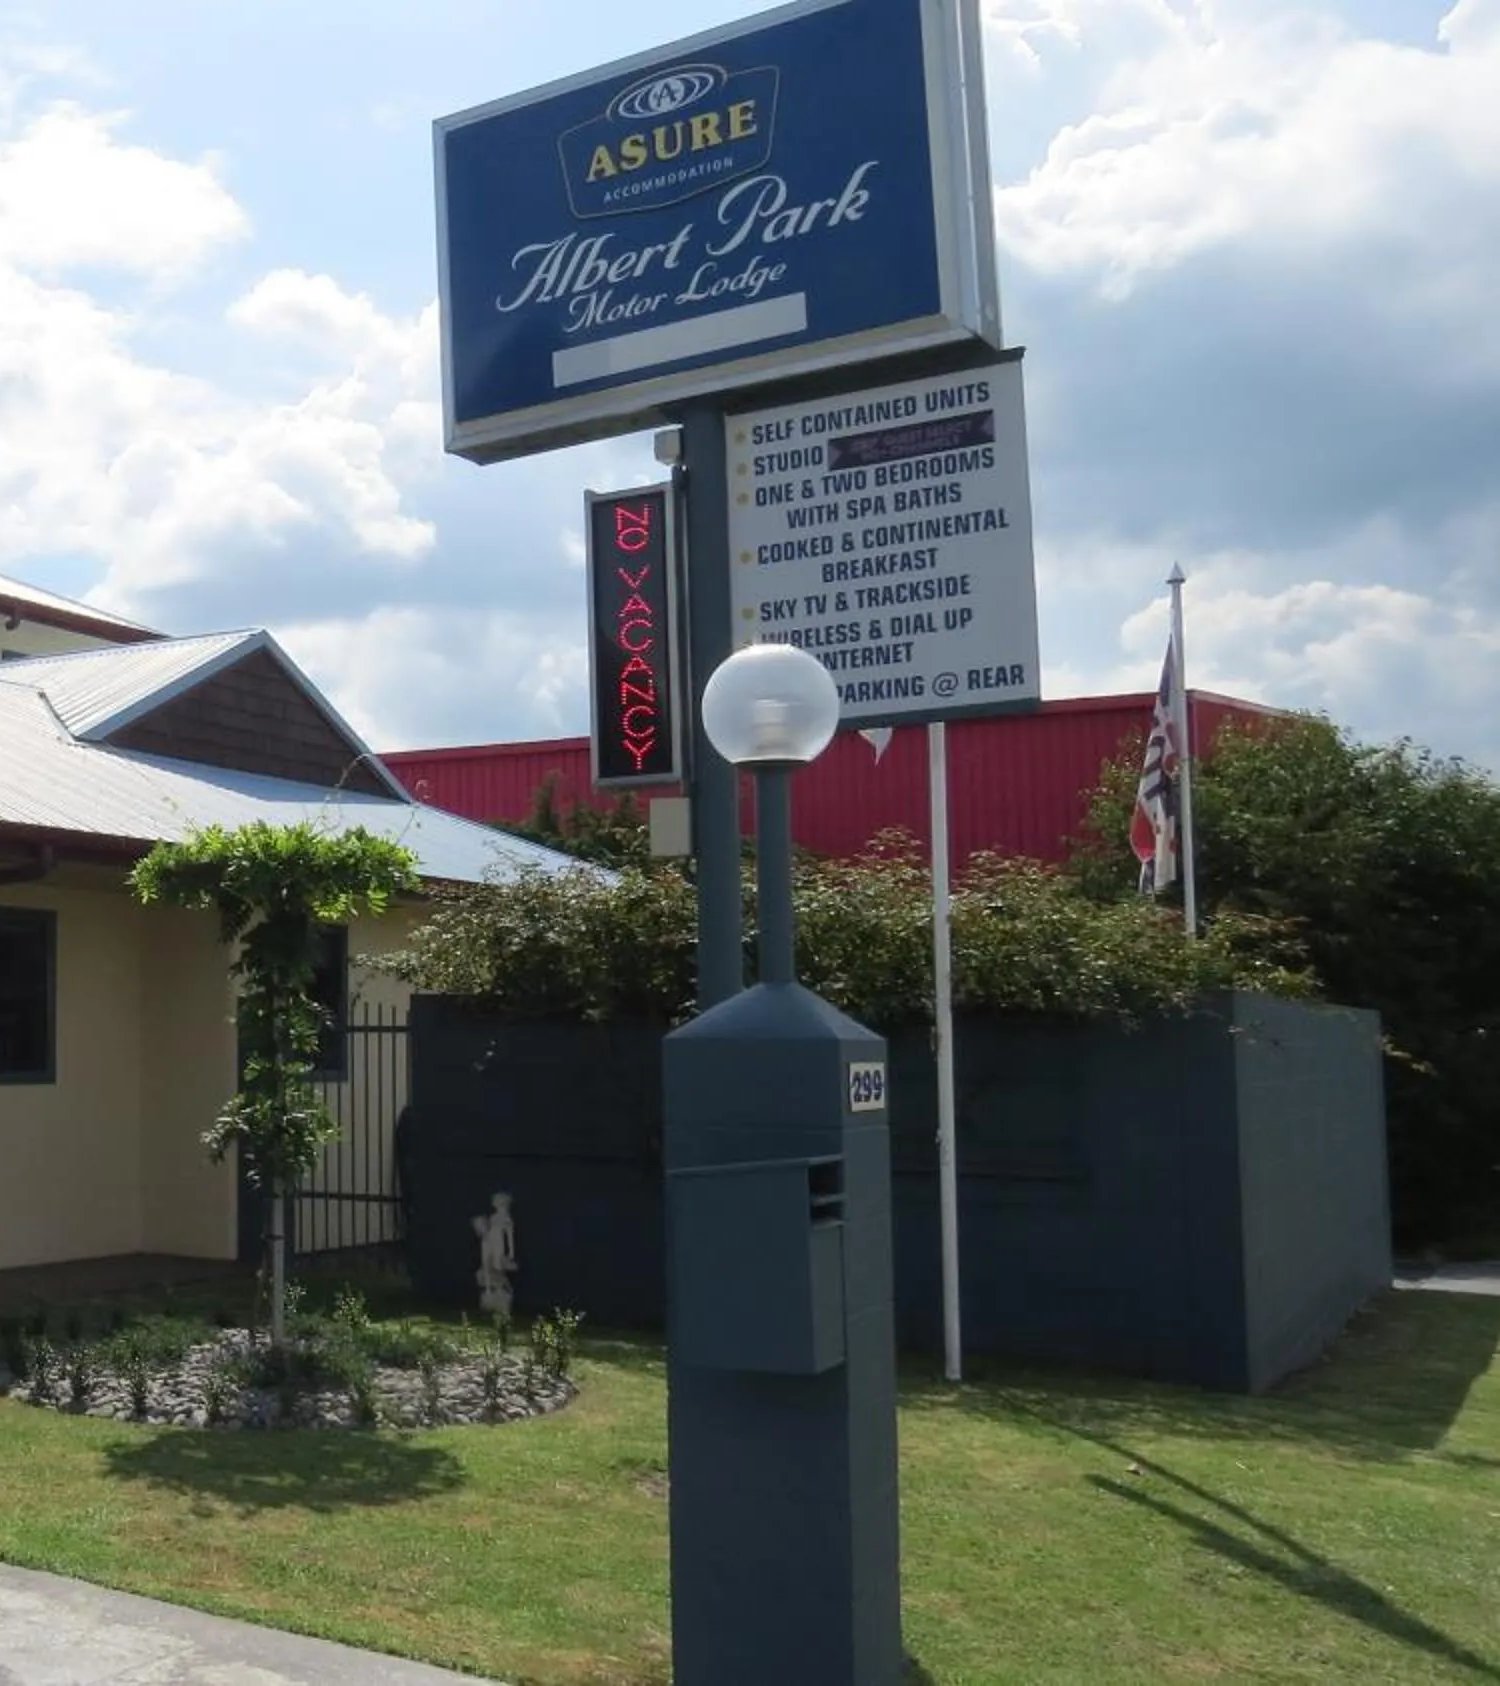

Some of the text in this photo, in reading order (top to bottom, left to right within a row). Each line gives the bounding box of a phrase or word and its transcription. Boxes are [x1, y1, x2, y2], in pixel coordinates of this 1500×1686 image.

[586, 99, 759, 183] ASURE
[603, 157, 735, 204] ACCOMMODATION
[495, 160, 880, 313] Albert Park
[562, 254, 788, 334] Motor Lodge
[752, 381, 990, 445] SELF CONTAINED UNITS
[754, 446, 823, 476] STUDIO
[755, 448, 995, 507] ONE & TWO BEDROOMS
[787, 482, 962, 529] WITH SPA BATHS
[757, 508, 1010, 565] COOKED & CONTINENTAL
[822, 547, 940, 583] BREAKFAST
[760, 574, 971, 622] SKY TV & TRACKSIDE
[615, 503, 656, 770] NO VACANCY
[869, 619, 883, 641] &
[890, 613, 937, 637] DIAL
[944, 607, 973, 631] UP
[931, 671, 960, 697] @
[967, 664, 1025, 691] REAR
[852, 1070, 884, 1103] 299
